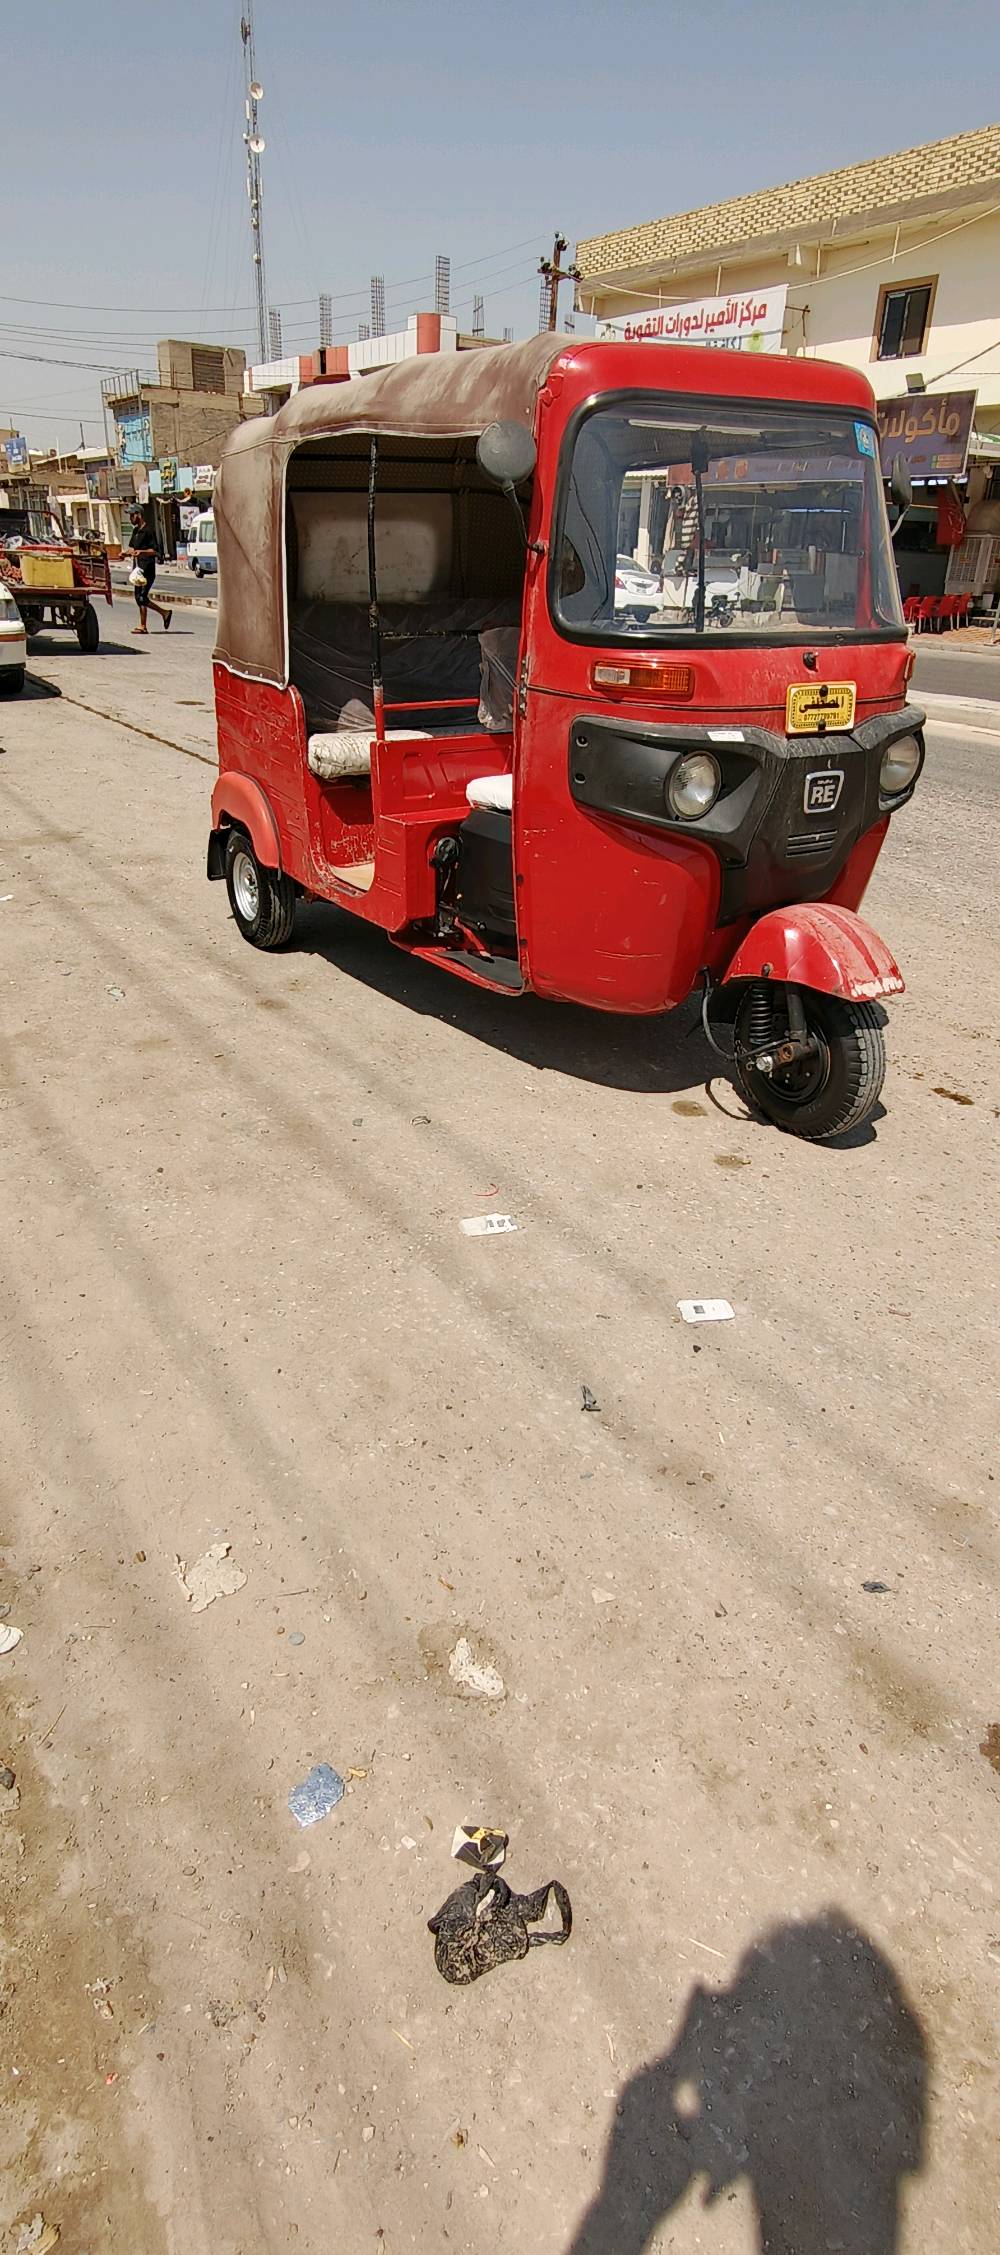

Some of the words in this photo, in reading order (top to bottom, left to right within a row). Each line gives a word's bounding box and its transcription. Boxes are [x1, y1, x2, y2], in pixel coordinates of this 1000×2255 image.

[665, 308, 704, 337] لدورات
[706, 298, 738, 333] الأمير
[739, 298, 767, 328] مركز
[624, 315, 664, 342] التقوية
[811, 785, 835, 804] RE
